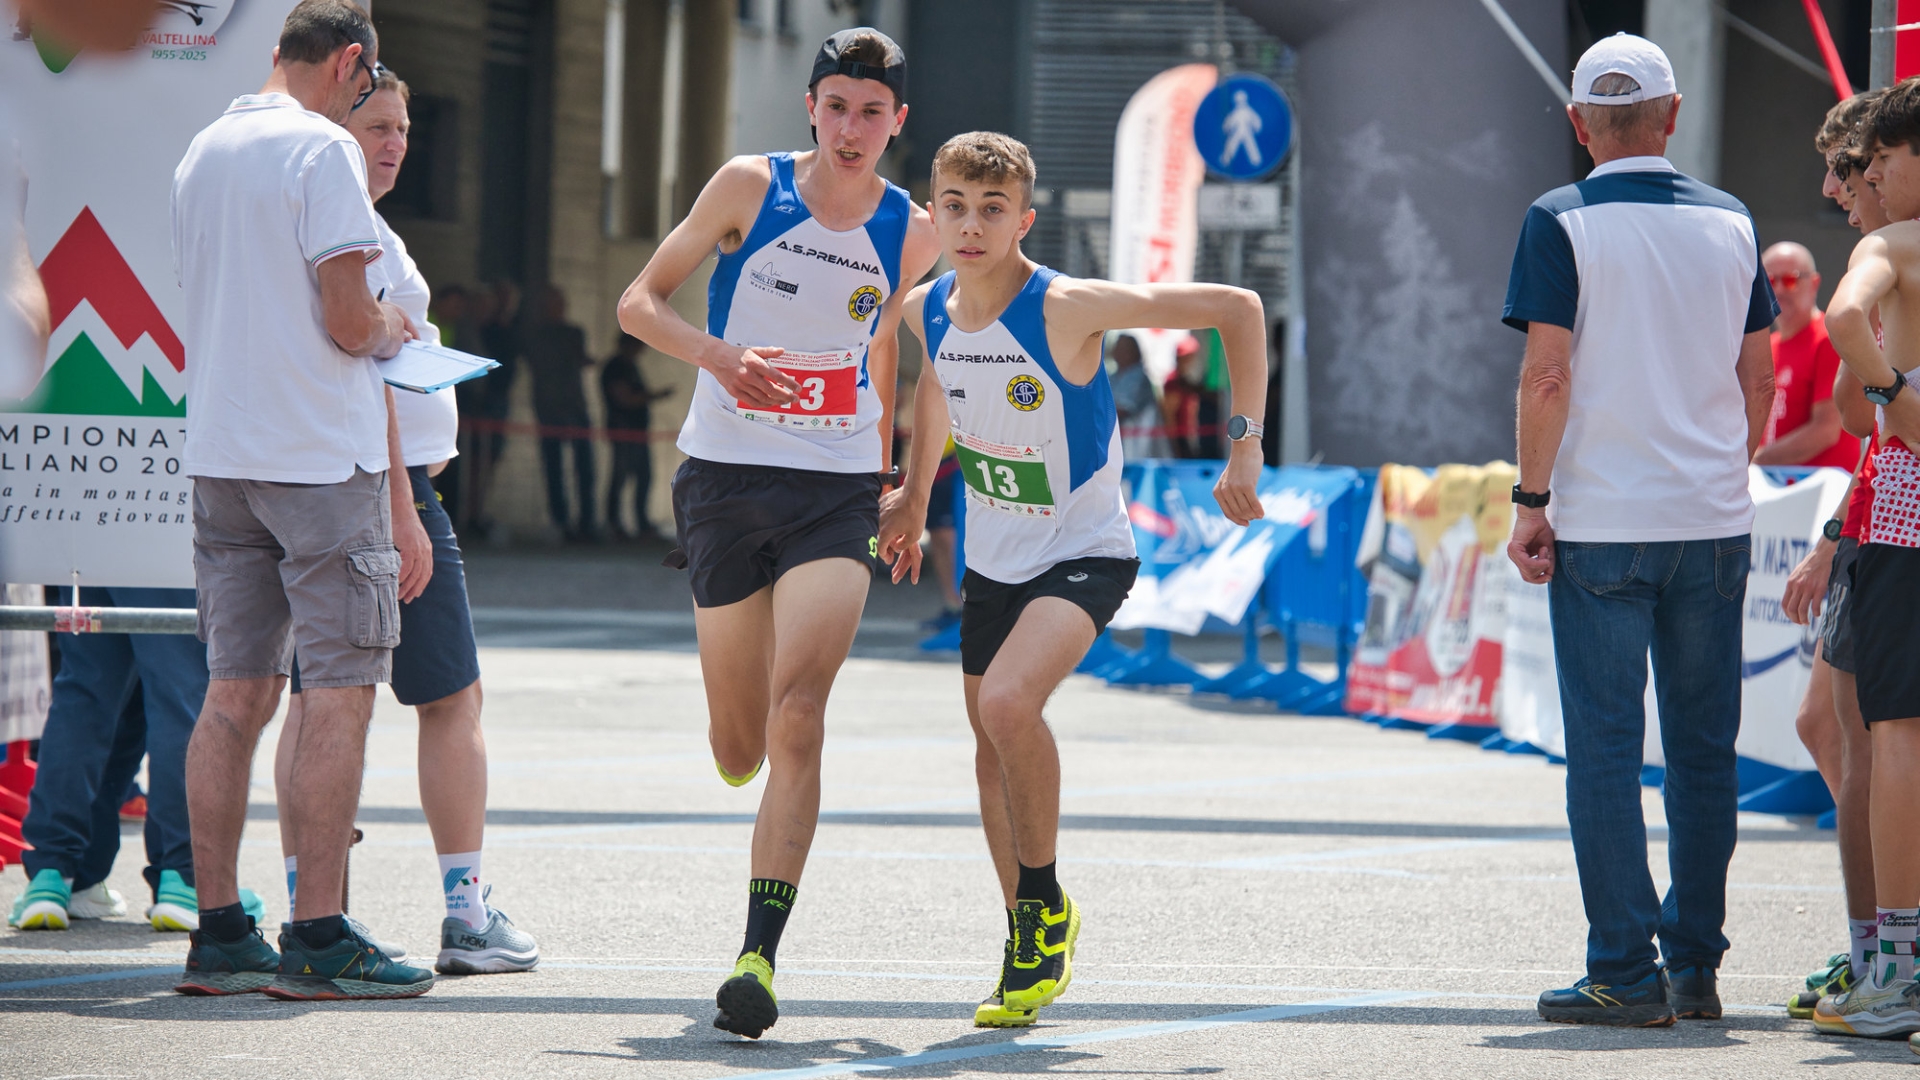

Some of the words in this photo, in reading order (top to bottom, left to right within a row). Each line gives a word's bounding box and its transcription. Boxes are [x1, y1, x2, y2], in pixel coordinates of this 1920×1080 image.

[142, 34, 217, 46] VALTELLINA
[151, 49, 207, 60] 1955-2025
[776, 240, 880, 275] A.S.PREMANA
[777, 281, 797, 293] NERO
[939, 351, 1027, 364] A.S.PREMANA
[2, 453, 118, 473] LIANO
[141, 457, 180, 475] 20
[975, 459, 1020, 498] 13
[2, 486, 13, 497] a
[35, 484, 60, 498] in
[83, 489, 188, 505] montag
[0, 505, 81, 522] ffetta
[459, 934, 488, 950] HOKA
